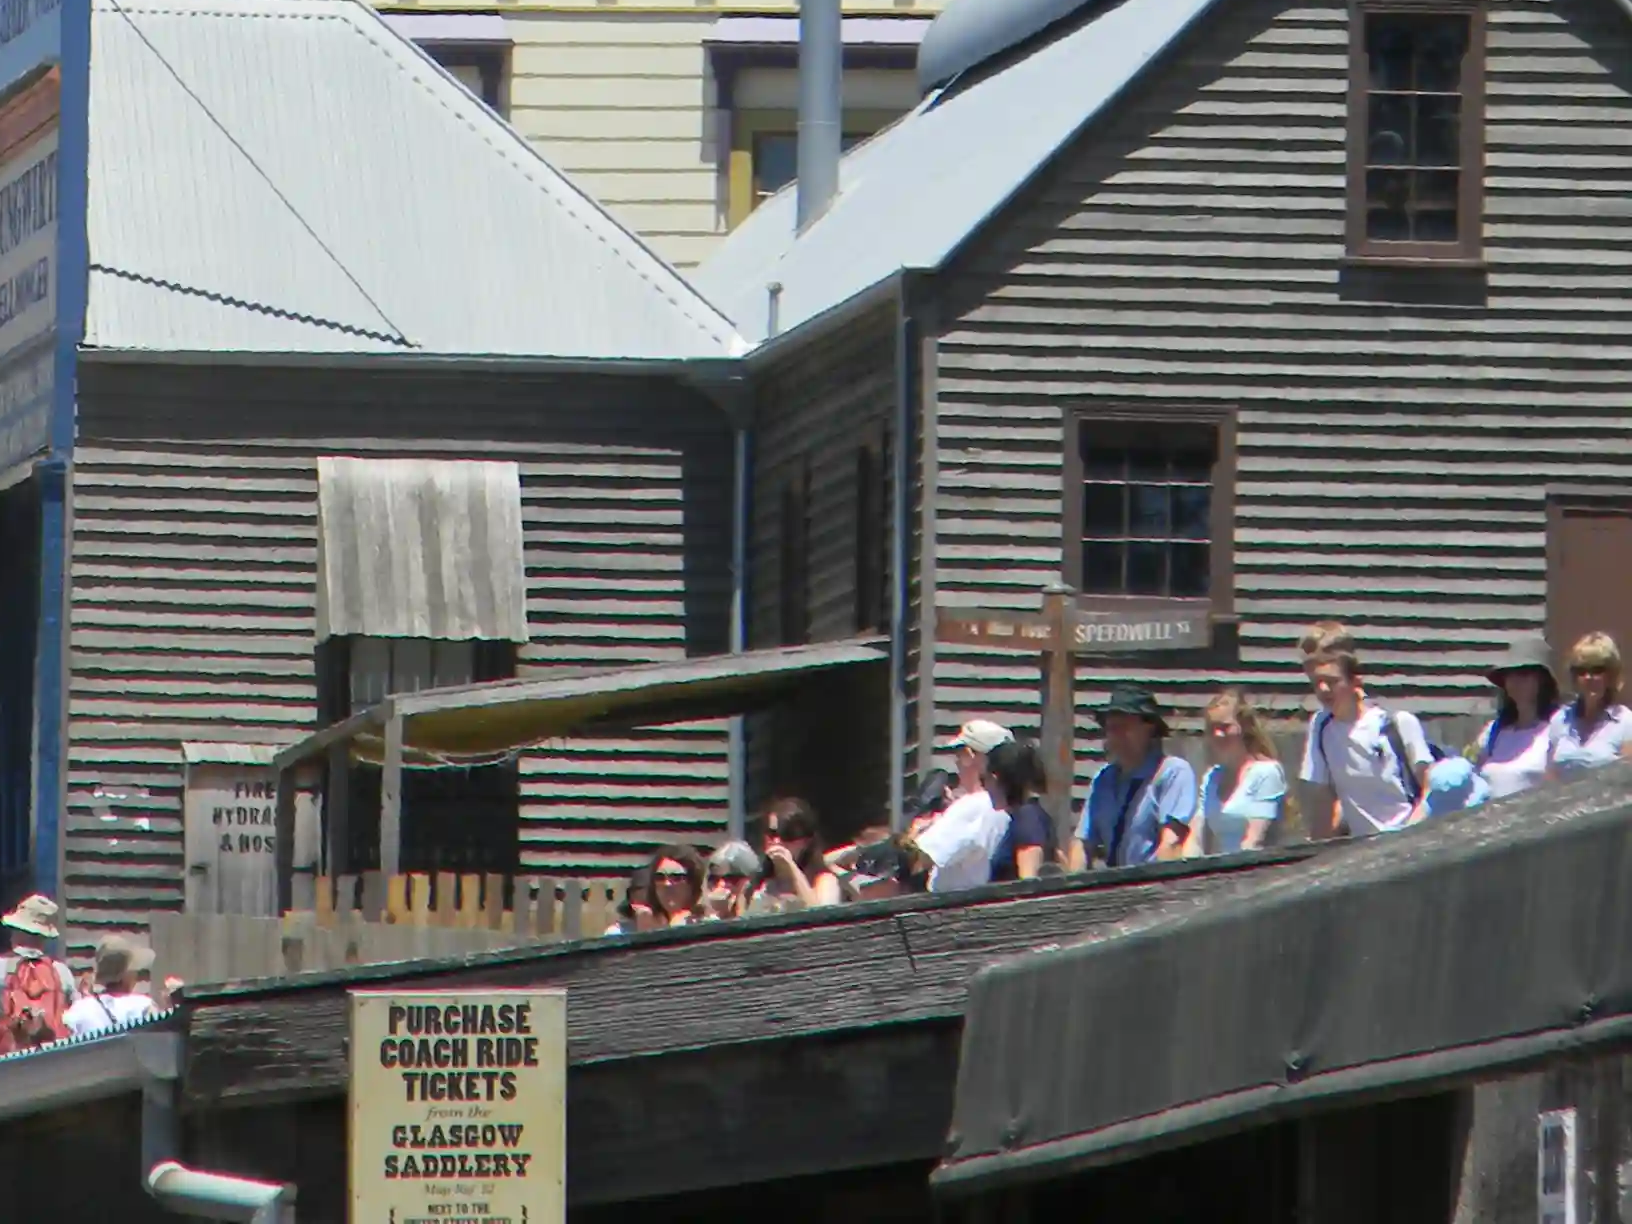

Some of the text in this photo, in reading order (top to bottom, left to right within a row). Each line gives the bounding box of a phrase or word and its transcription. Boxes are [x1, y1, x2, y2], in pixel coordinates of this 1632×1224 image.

[235, 781, 276, 799] FIRE
[213, 806, 277, 826] HYDRA
[220, 833, 233, 852] &
[388, 1004, 532, 1035] PURCHASE
[380, 1037, 539, 1068] COACH RIDE
[402, 1072, 517, 1101] TICKETS
[424, 1103, 493, 1122] from the
[392, 1125, 524, 1147] GLASGOW
[384, 1154, 532, 1178] SADDLERY
[428, 1203, 491, 1214] NEXT TO THE
